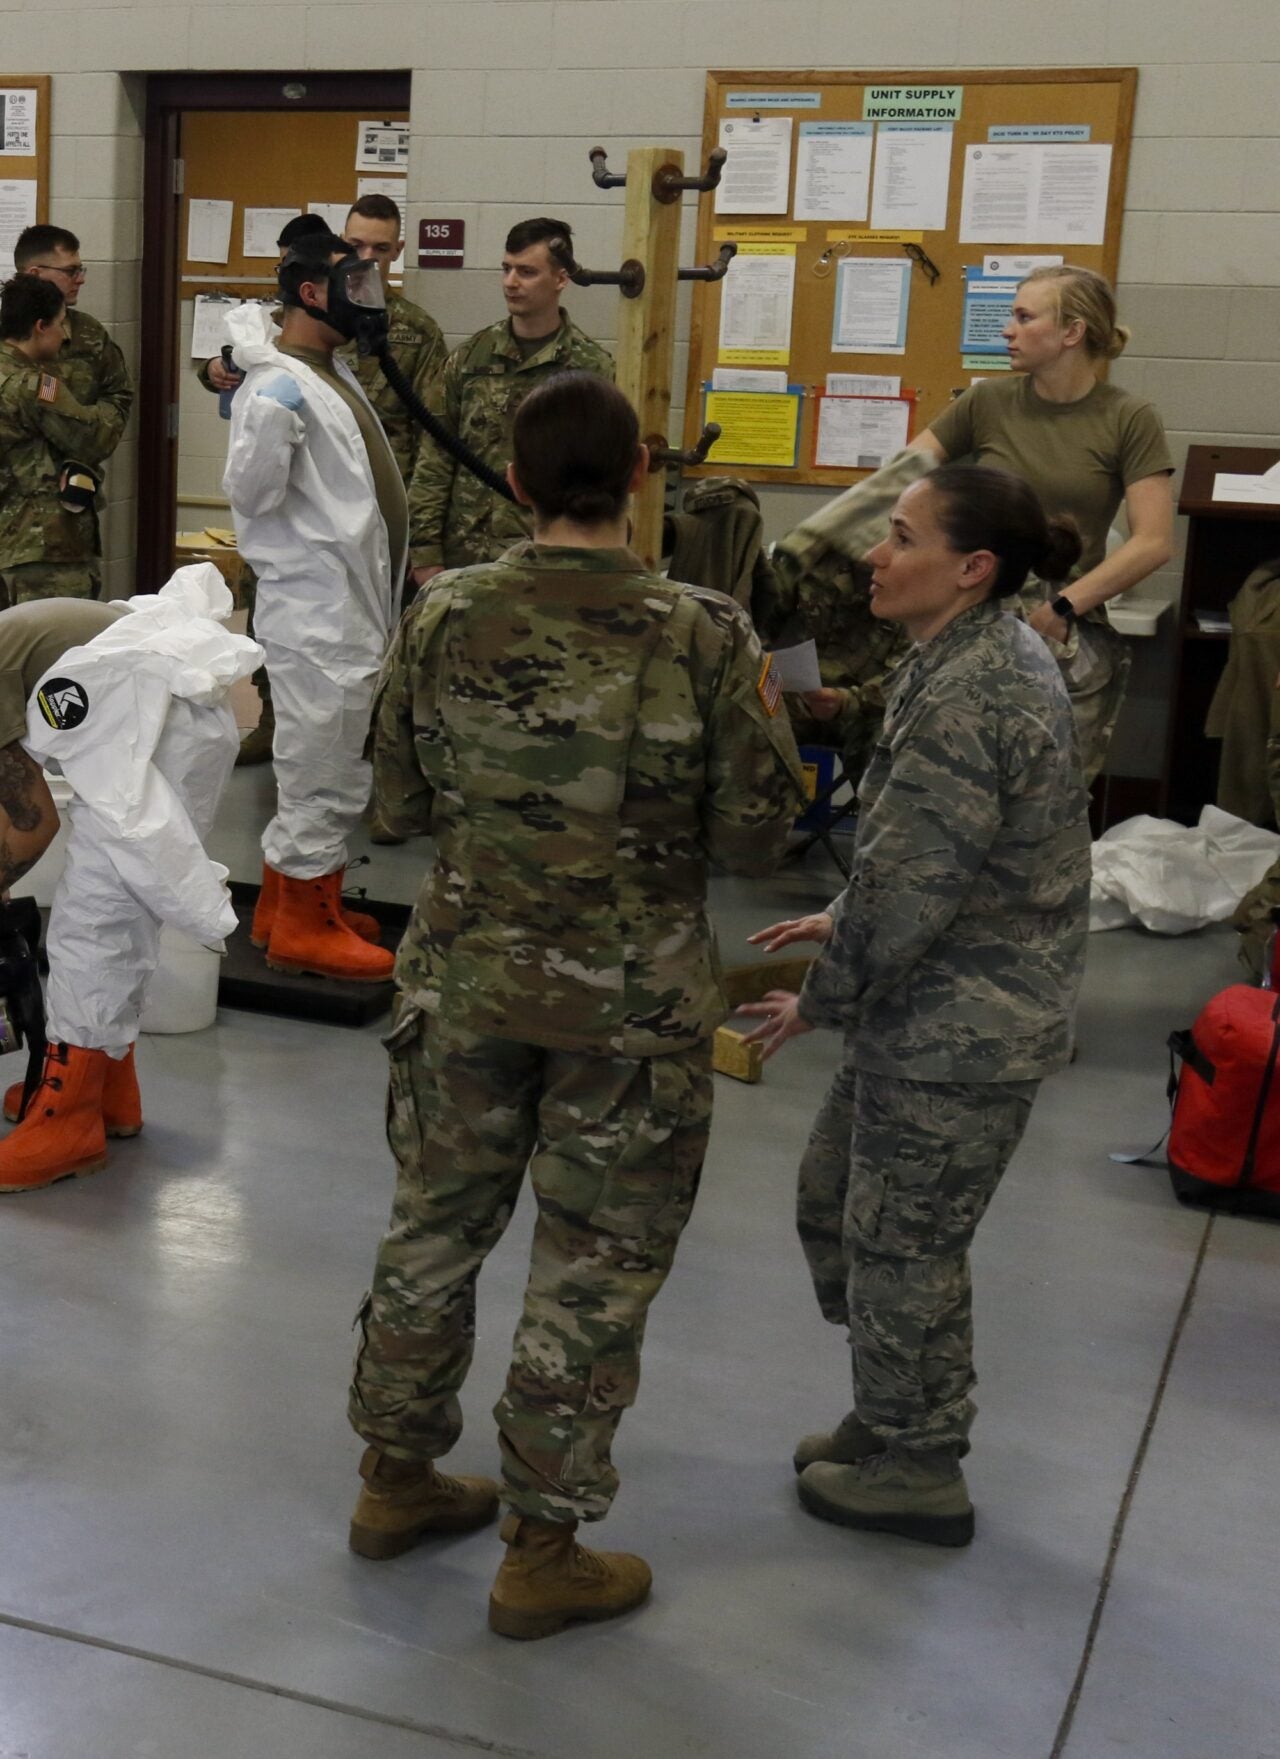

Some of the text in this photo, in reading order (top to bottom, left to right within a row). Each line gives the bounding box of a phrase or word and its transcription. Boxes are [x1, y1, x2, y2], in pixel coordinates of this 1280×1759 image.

[871, 90, 956, 99] UNIT SUPPLY
[867, 108, 956, 117] INFORMATION
[425, 224, 450, 238] 135
